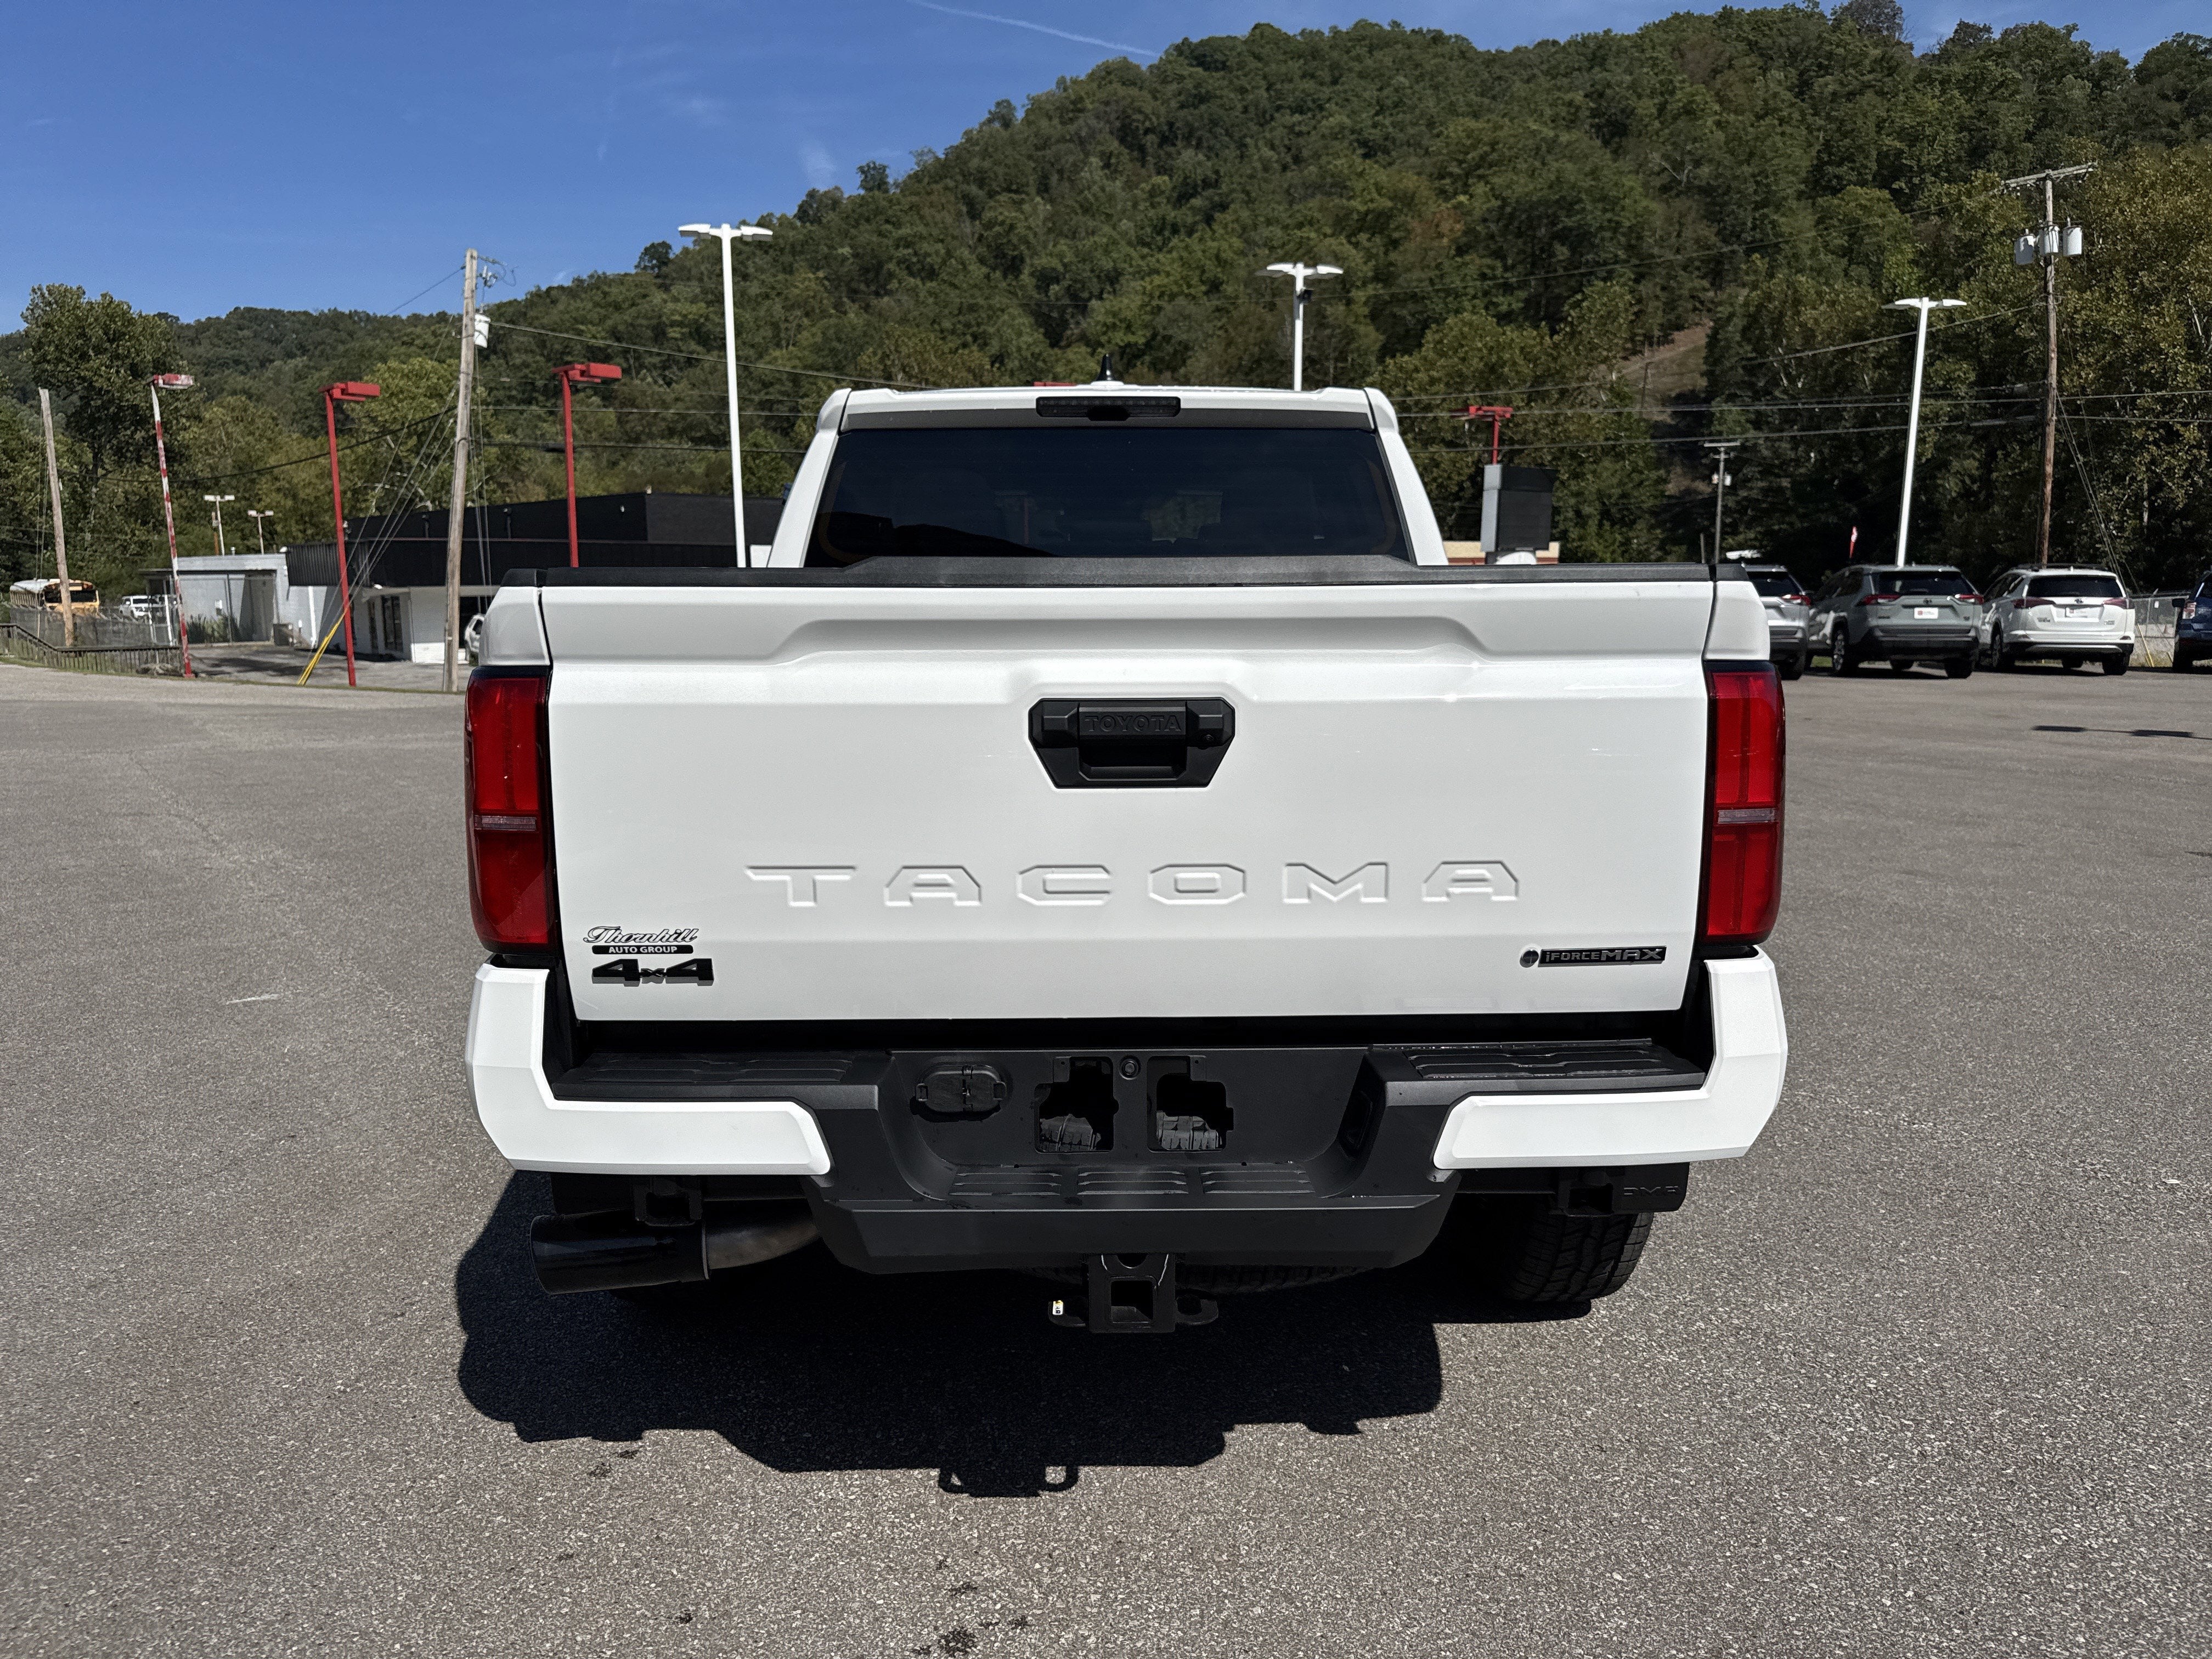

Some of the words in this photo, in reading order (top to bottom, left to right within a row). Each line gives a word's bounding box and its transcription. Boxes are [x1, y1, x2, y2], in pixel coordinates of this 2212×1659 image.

[1084, 715, 1182, 732] TOYOTA
[745, 861, 1519, 907] TACOMA
[583, 926, 699, 944] Thornhill
[608, 946, 638, 954] AUTO
[639, 945, 678, 954] GROUP
